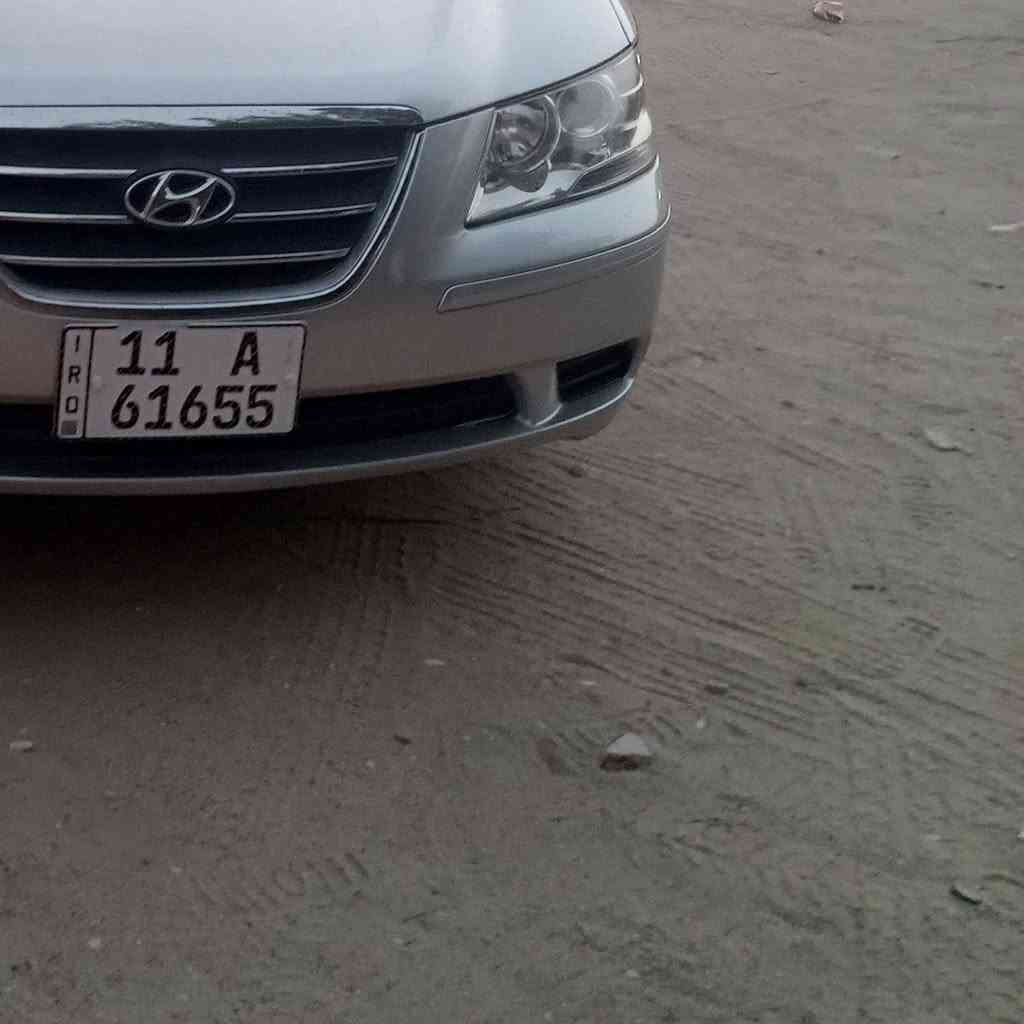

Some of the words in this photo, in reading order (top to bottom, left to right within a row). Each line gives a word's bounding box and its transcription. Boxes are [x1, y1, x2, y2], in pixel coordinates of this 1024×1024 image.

[117, 330, 180, 376] 11
[230, 331, 260, 376] A
[111, 384, 278, 430] 61655
